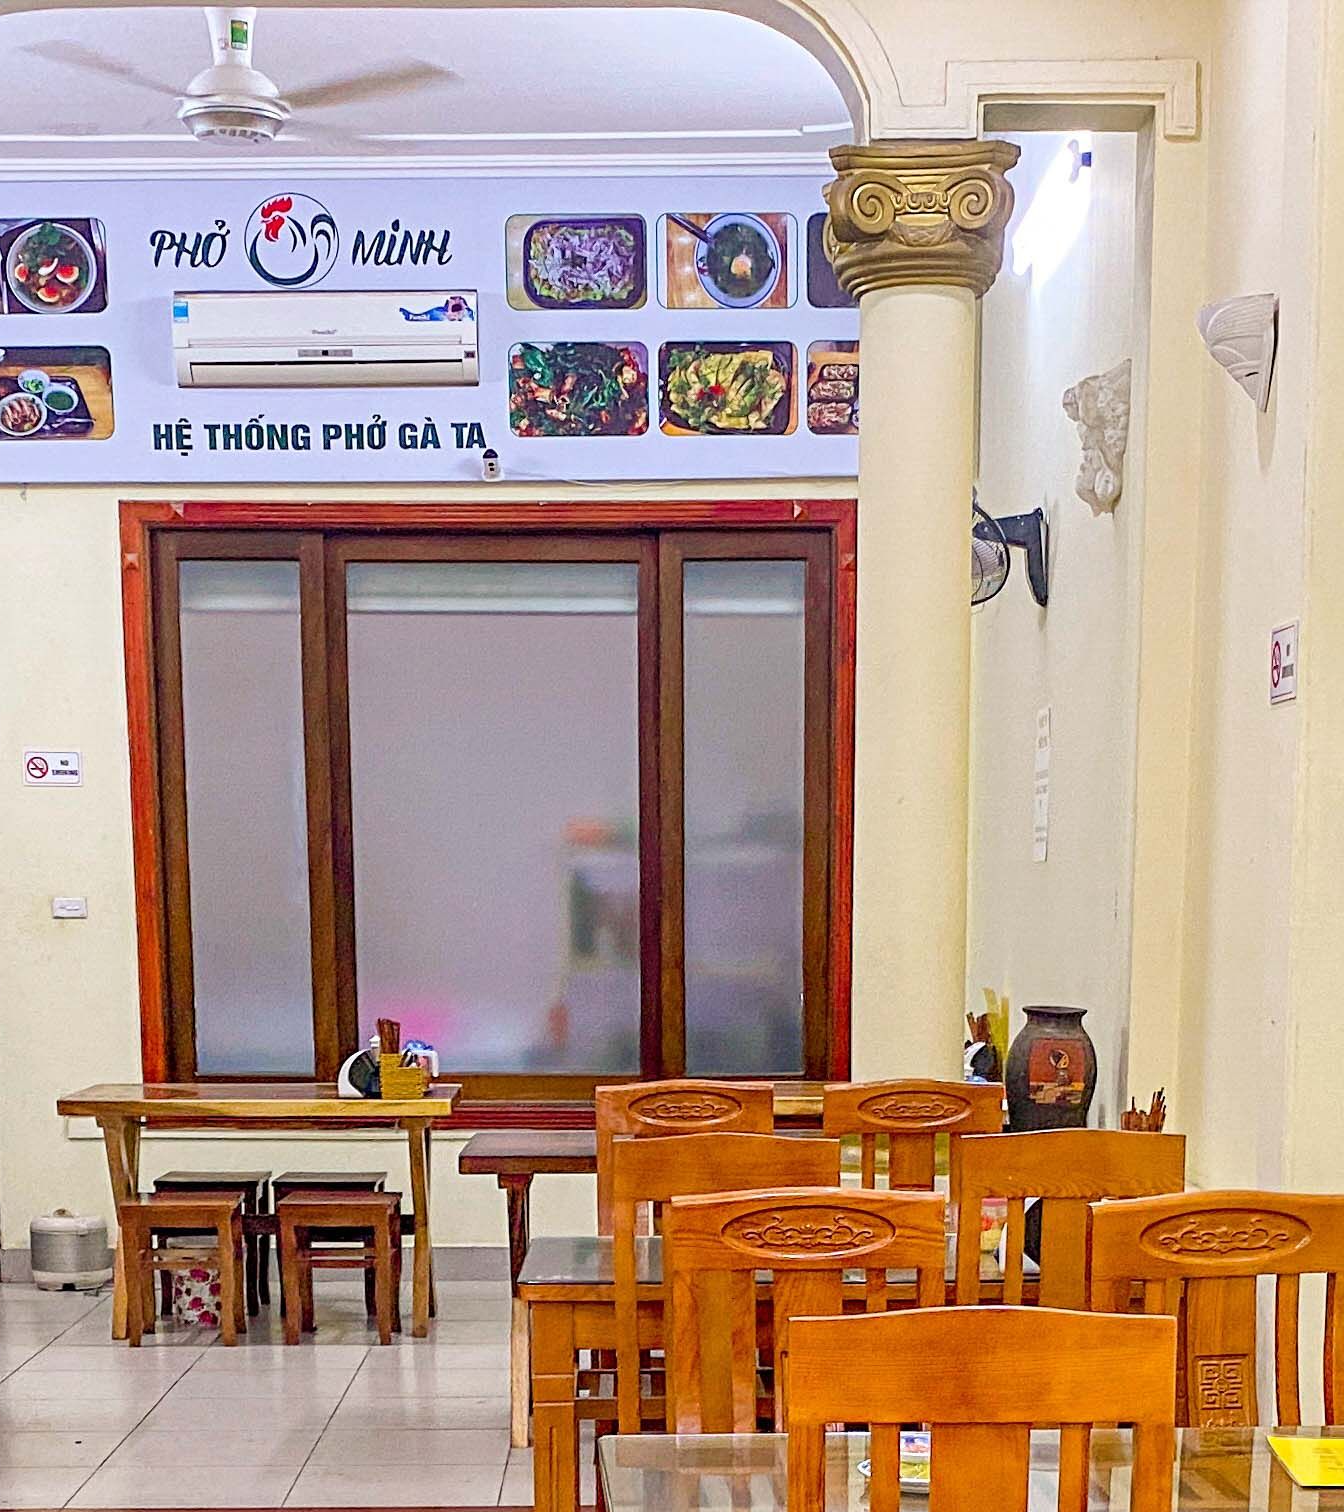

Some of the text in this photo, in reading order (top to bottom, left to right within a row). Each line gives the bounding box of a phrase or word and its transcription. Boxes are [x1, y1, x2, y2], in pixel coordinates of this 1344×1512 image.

[150, 219, 230, 268] PHỞ
[153, 414, 487, 456] HỆ THỐNG PHỞ GÀ TA
